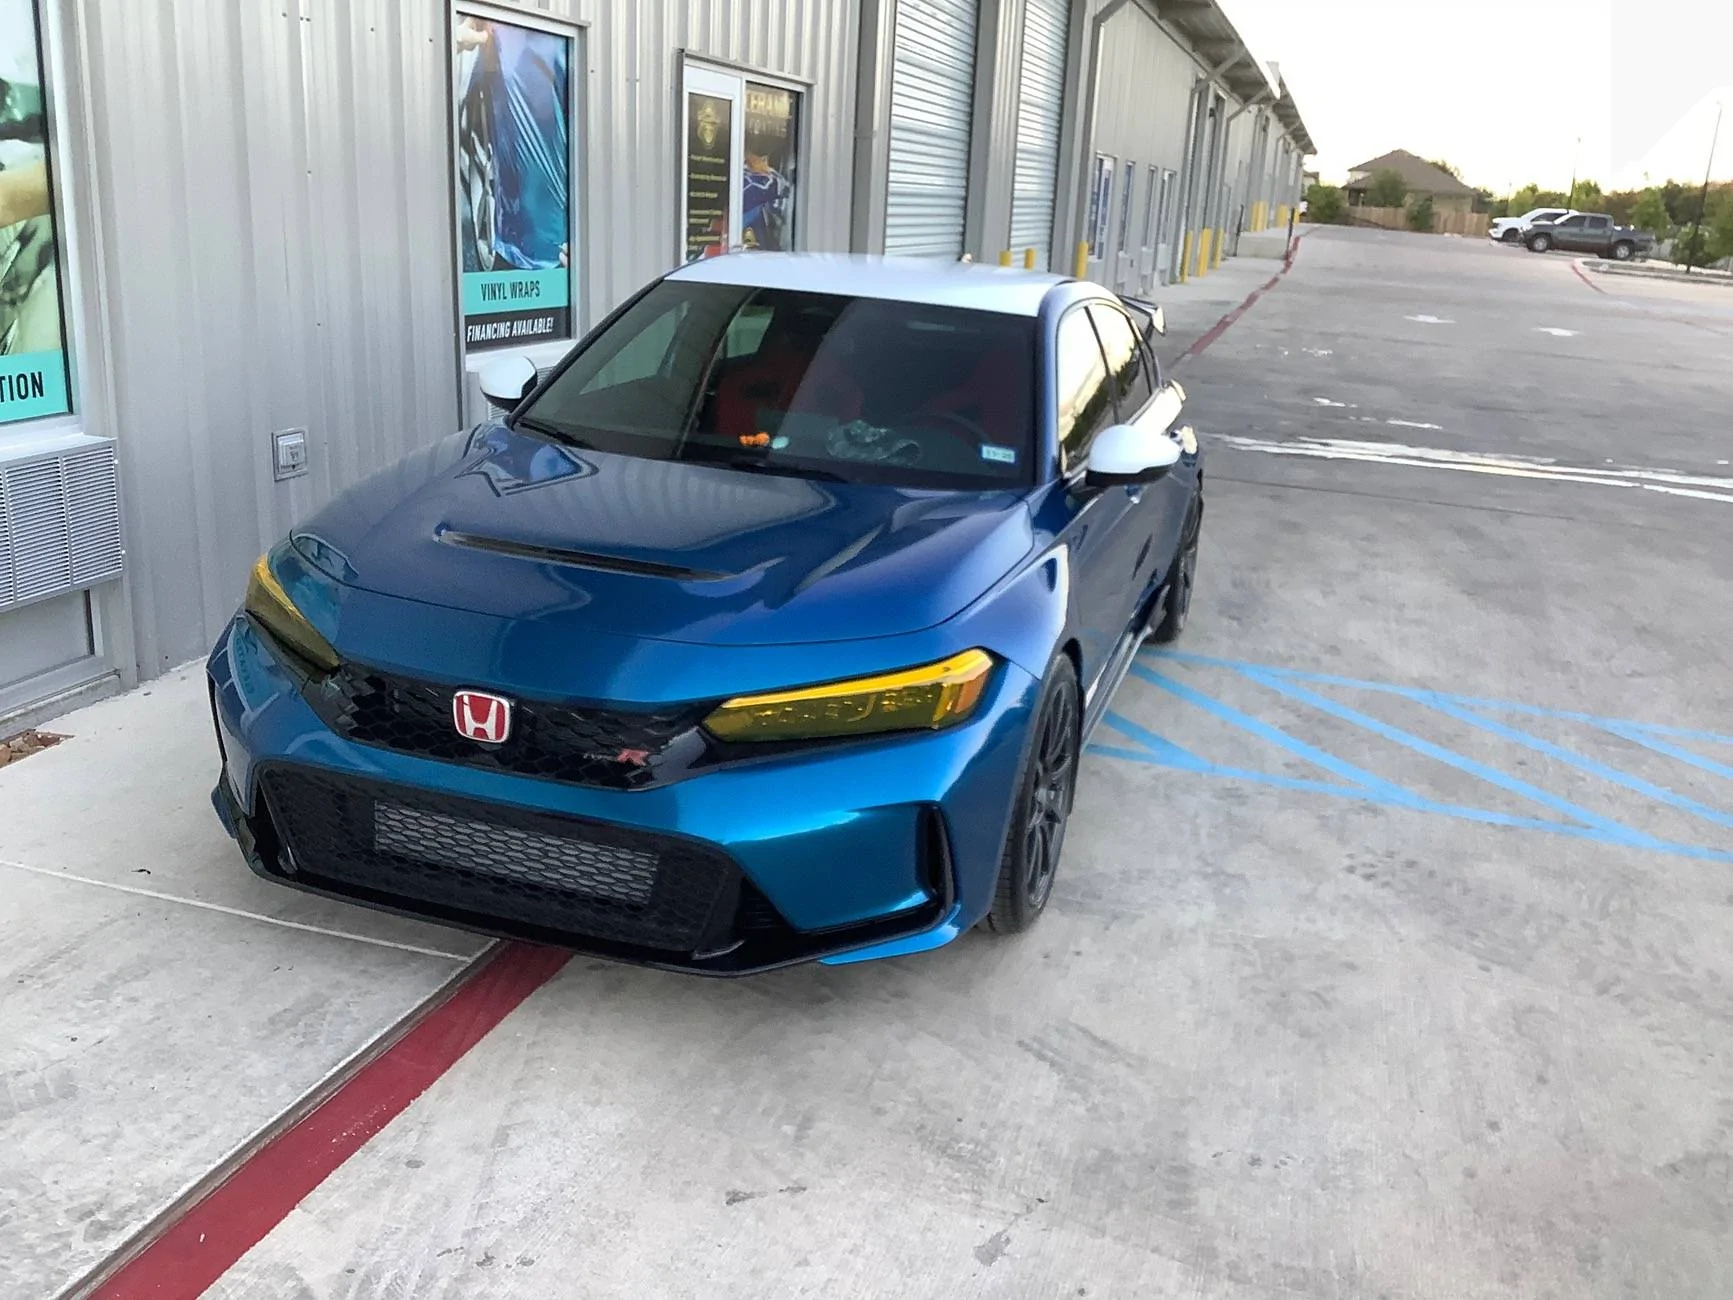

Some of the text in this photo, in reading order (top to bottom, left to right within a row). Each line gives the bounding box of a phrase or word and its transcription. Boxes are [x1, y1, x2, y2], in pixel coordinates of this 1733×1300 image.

[481, 280, 540, 301] VINYL WRAPS
[467, 317, 554, 342] FINANCING AVAILABLE!
[0, 371, 44, 403] TION
